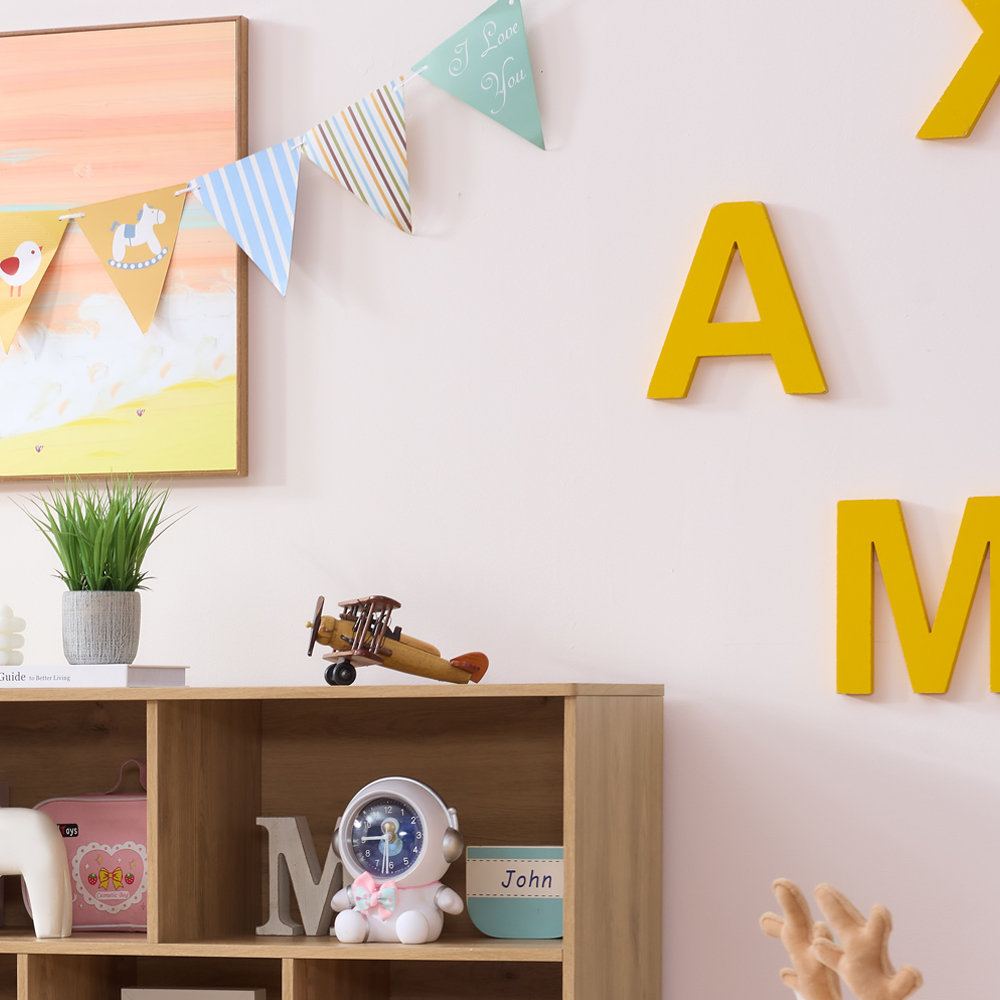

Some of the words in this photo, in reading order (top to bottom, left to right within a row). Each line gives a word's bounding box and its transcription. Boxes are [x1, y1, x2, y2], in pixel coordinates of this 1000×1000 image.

[481, 20, 519, 58] Love
[480, 56, 527, 114] You
[647, 201, 829, 400] A
[836, 496, 1000, 694] M
[410, 816, 417, 825] 2
[416, 831, 422, 839] 3
[365, 849, 371, 858] 8
[403, 857, 409, 866] 5
[389, 861, 394, 870] 6
[256, 816, 352, 936] M
[501, 869, 552, 888] John
